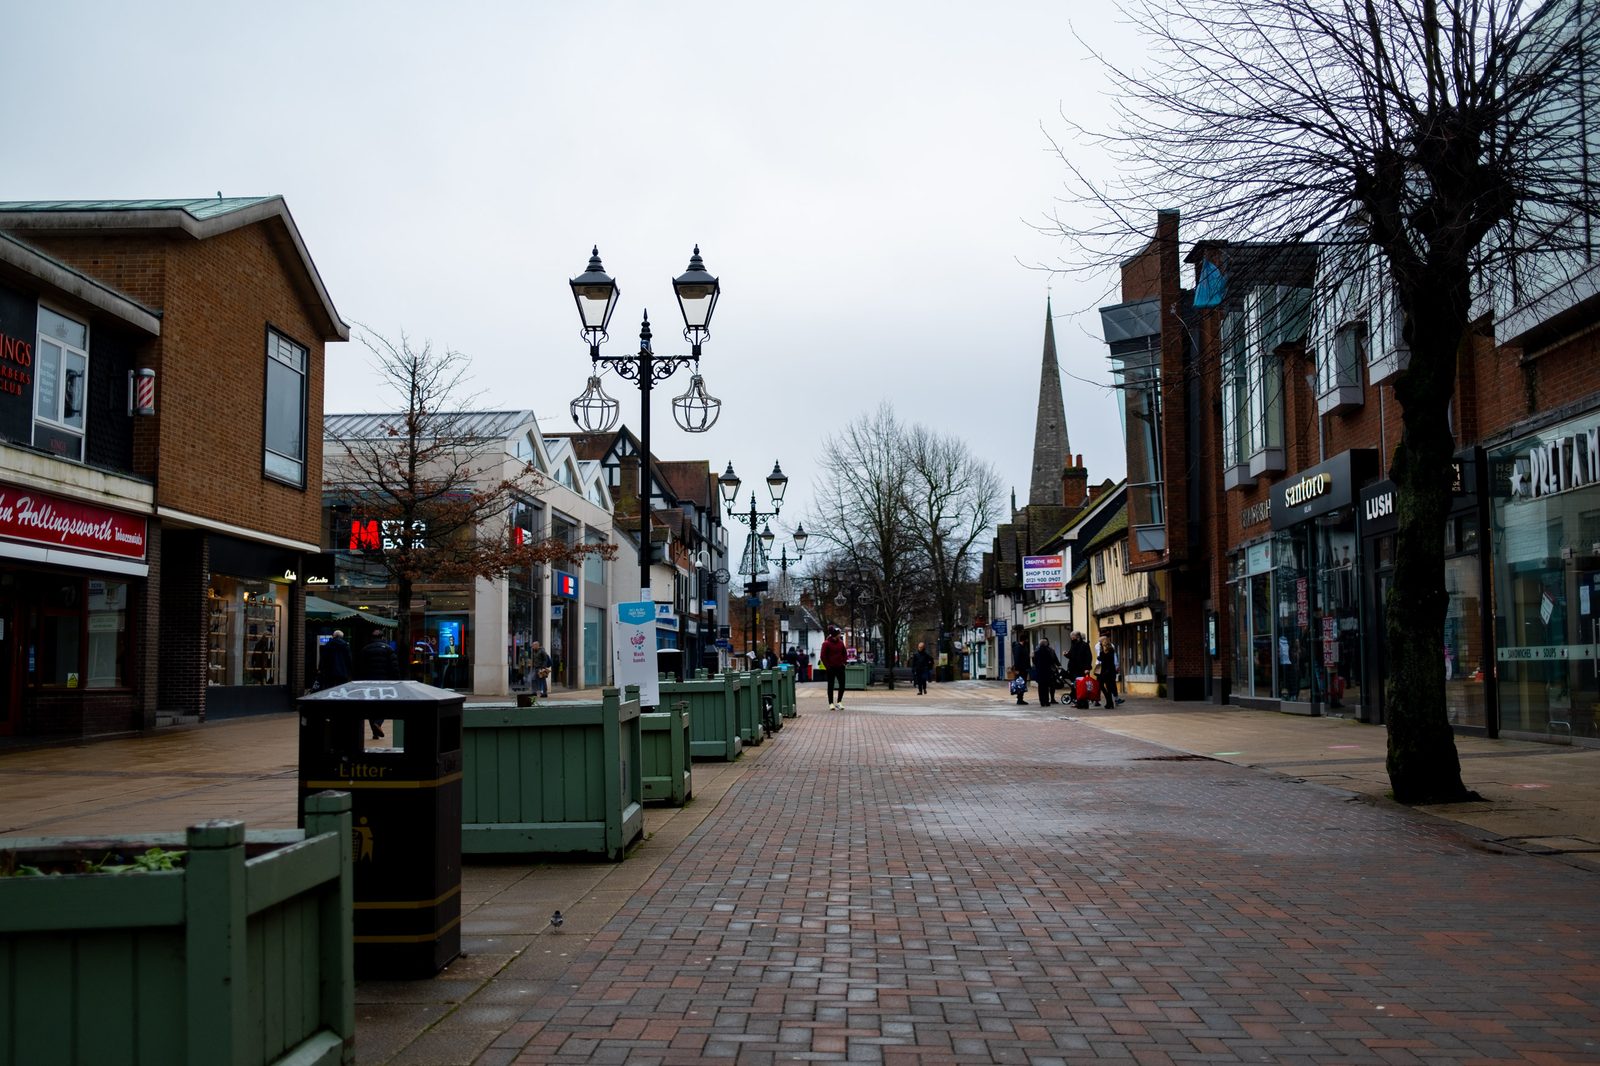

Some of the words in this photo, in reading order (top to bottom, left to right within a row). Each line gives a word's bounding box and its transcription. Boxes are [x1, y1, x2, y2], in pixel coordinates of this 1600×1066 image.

[1530, 438, 1566, 498] PRET
[1571, 434, 1582, 488] A
[1285, 473, 1324, 508] santoro
[1366, 492, 1393, 520] LUSH
[16, 496, 112, 541] Hollingsworth
[1507, 649, 1531, 659] SANDWICHES
[1543, 648, 1557, 658] SOUPS
[339, 762, 385, 778] Litter
